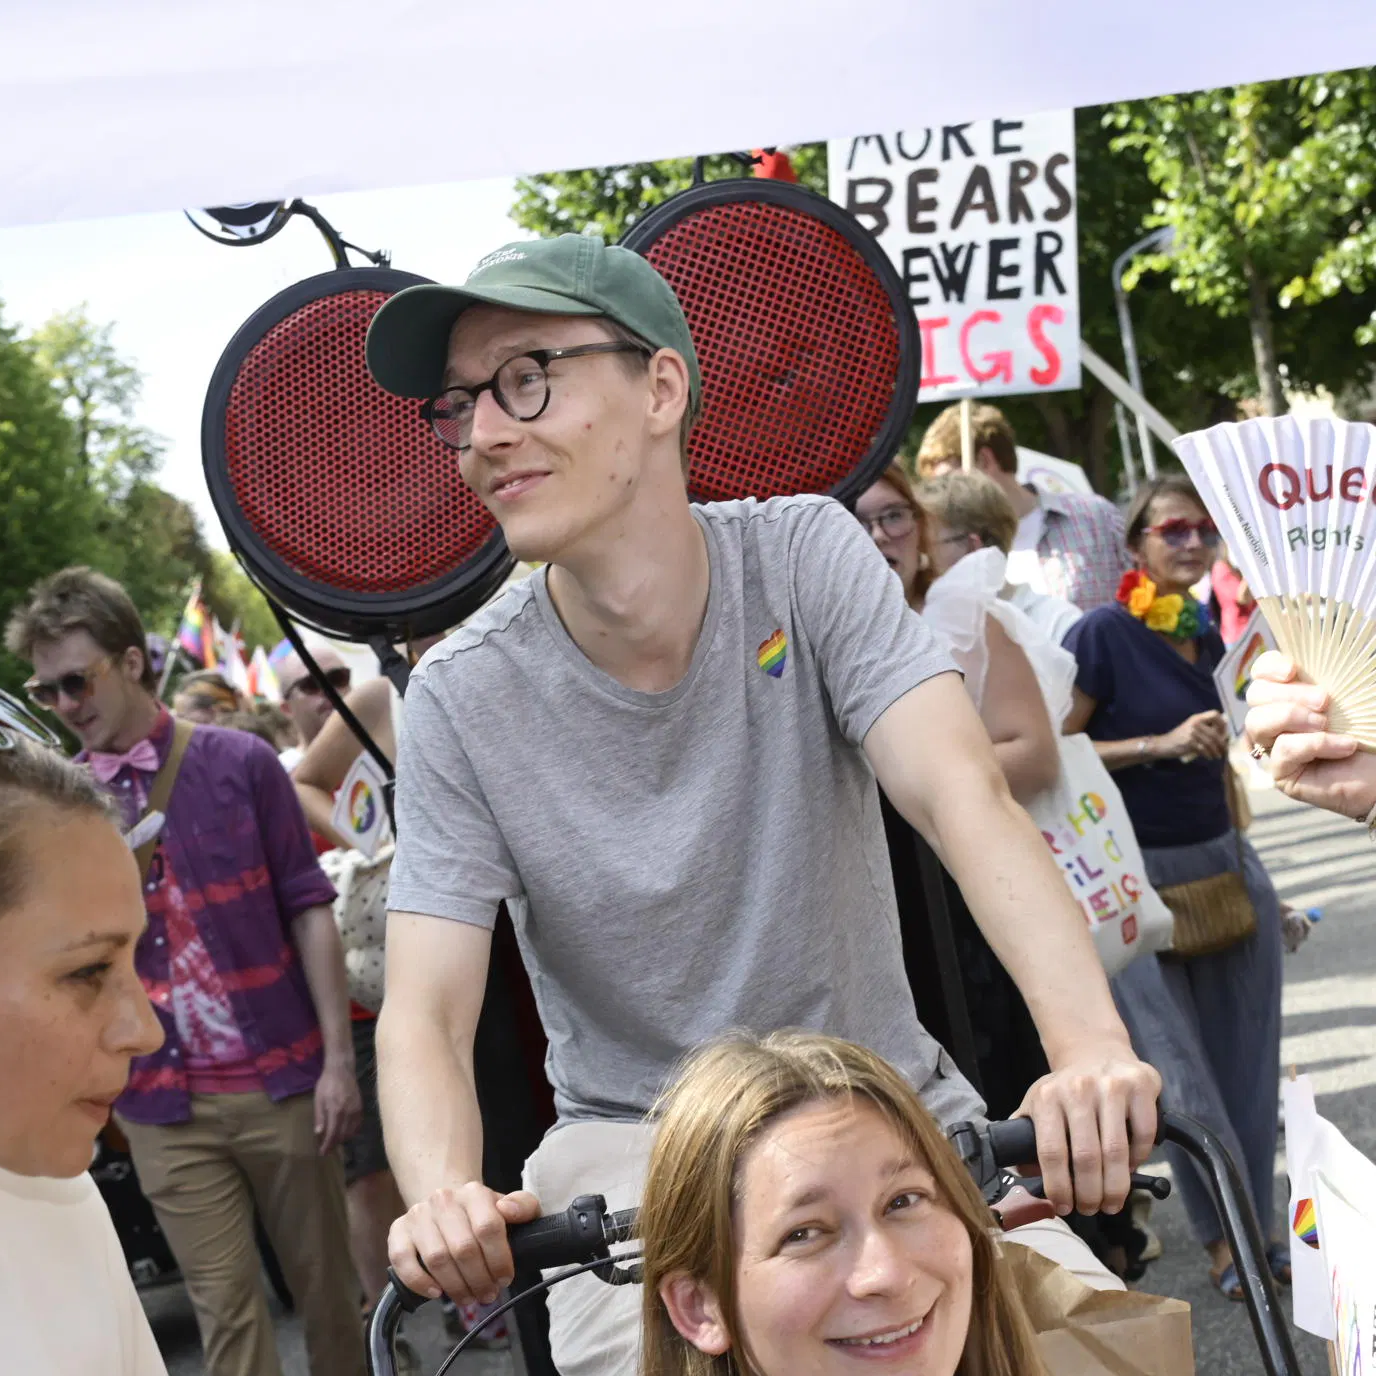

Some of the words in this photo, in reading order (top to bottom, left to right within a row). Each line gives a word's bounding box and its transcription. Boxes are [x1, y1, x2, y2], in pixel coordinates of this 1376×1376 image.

[846, 153, 1072, 238] BEARS
[902, 231, 1067, 306] EWER
[920, 304, 1065, 388] IGS
[1287, 524, 1365, 552] Rights
